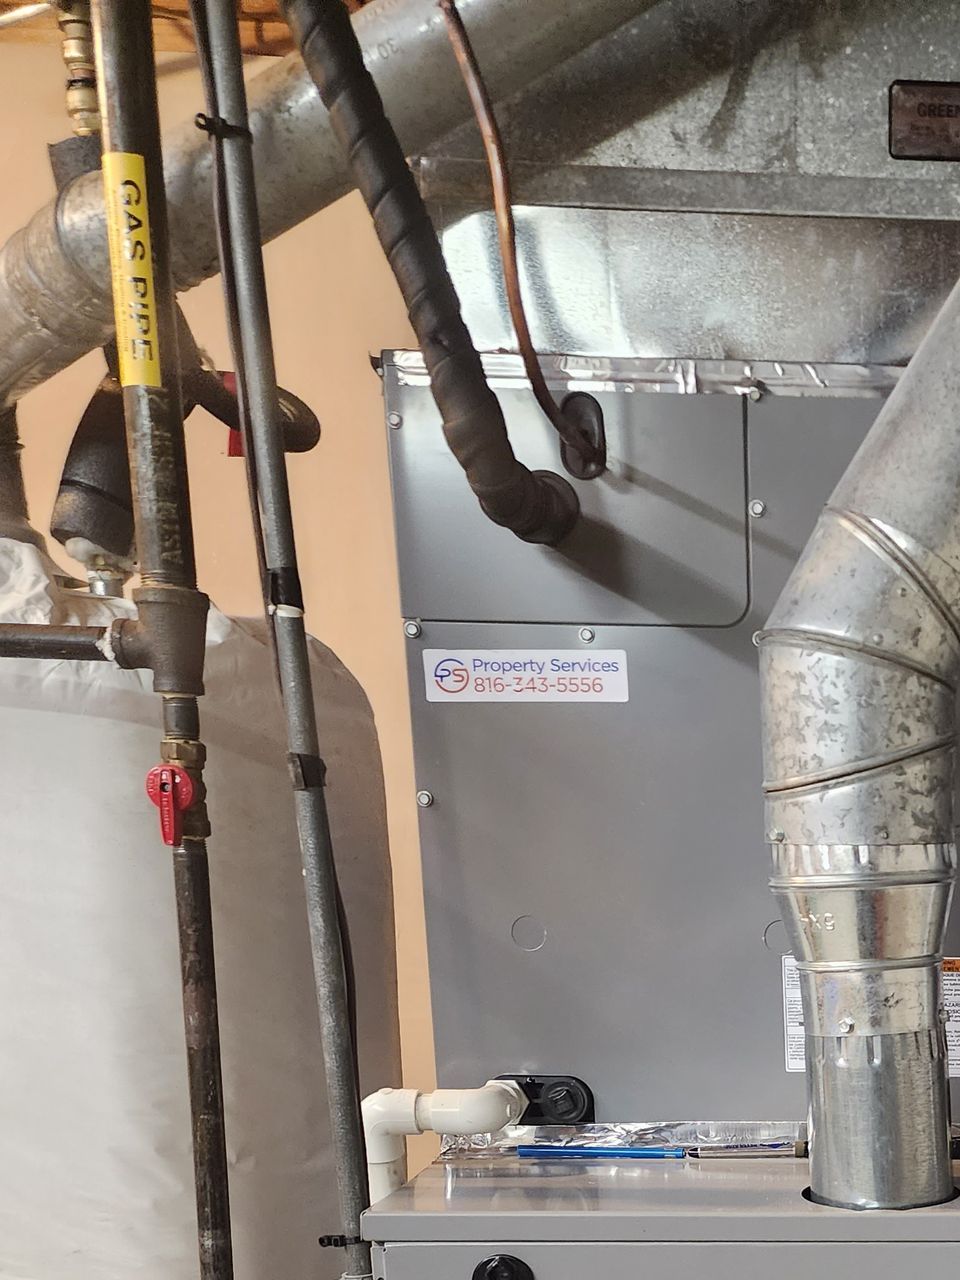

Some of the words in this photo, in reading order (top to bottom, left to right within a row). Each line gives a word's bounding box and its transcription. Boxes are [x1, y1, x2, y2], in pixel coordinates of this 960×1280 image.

[121, 179, 146, 262] GAS
[120, 276, 153, 361] PIPE
[472, 658, 545, 675] Property
[550, 657, 619, 673] Services
[474, 676, 604, 693] 816-343-5556
